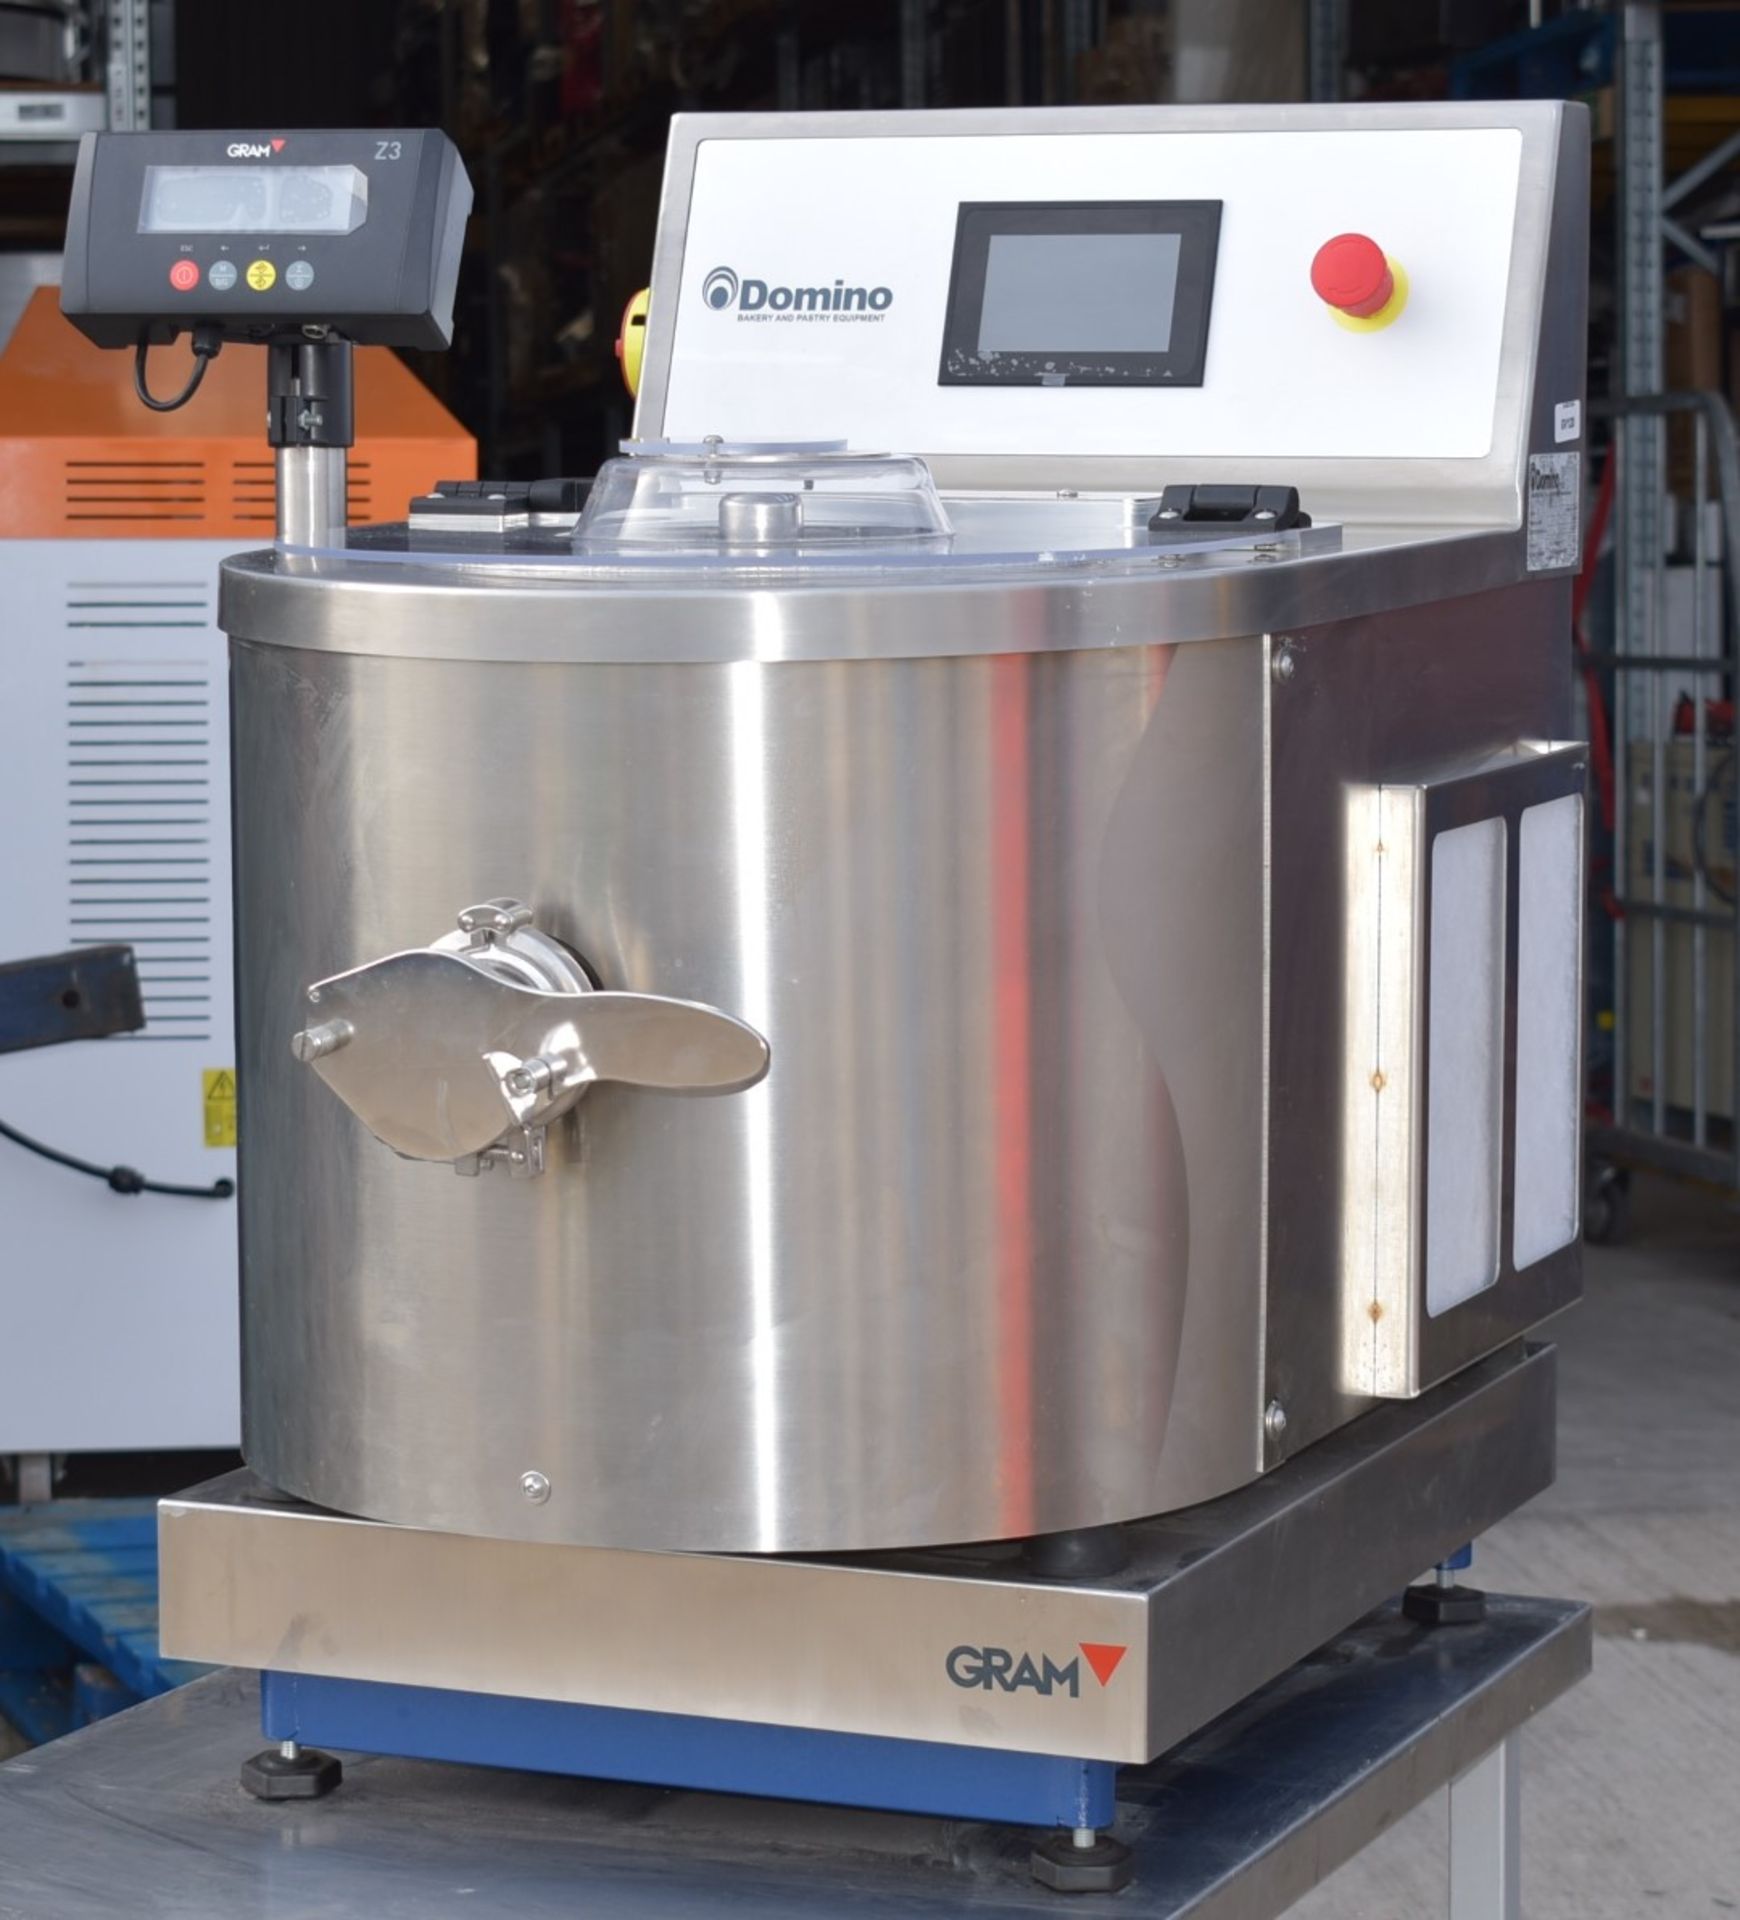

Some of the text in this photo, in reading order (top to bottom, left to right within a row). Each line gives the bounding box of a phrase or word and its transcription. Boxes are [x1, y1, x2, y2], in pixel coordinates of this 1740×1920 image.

[227, 143, 270, 158] GRAM
[374, 141, 402, 160] Z3
[739, 279, 893, 311] Domino
[737, 313, 885, 322] BAKERY AND PASTRY EQUIPMENT
[945, 1645, 1079, 1698] GRAM
